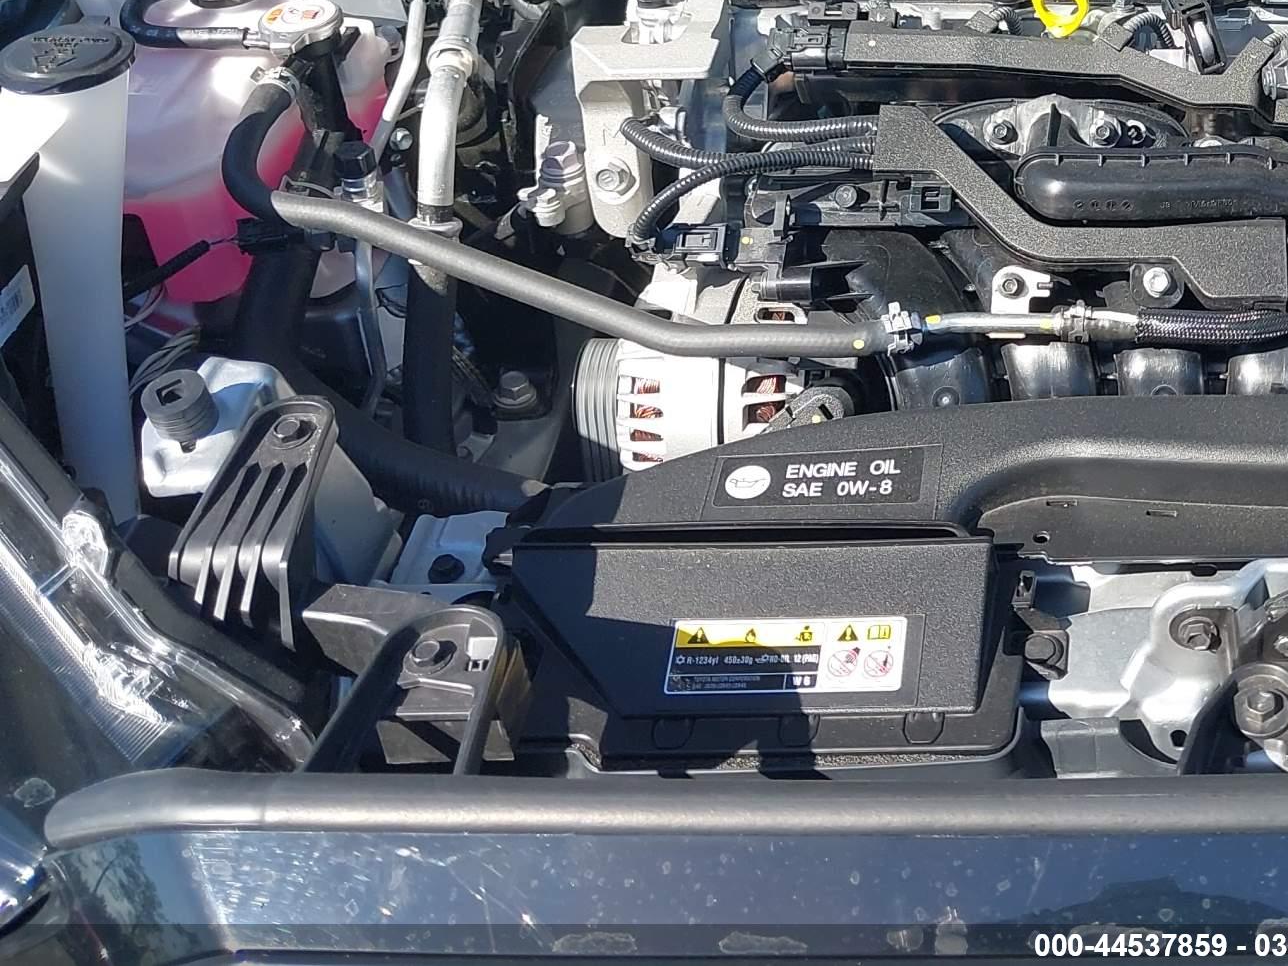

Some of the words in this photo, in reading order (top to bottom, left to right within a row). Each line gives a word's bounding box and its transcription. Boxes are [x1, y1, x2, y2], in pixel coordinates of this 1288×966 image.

[785, 461, 857, 479] ENGINE
[869, 459, 900, 475] OIL
[782, 481, 823, 498] SAE
[836, 479, 893, 497] 0W-8
